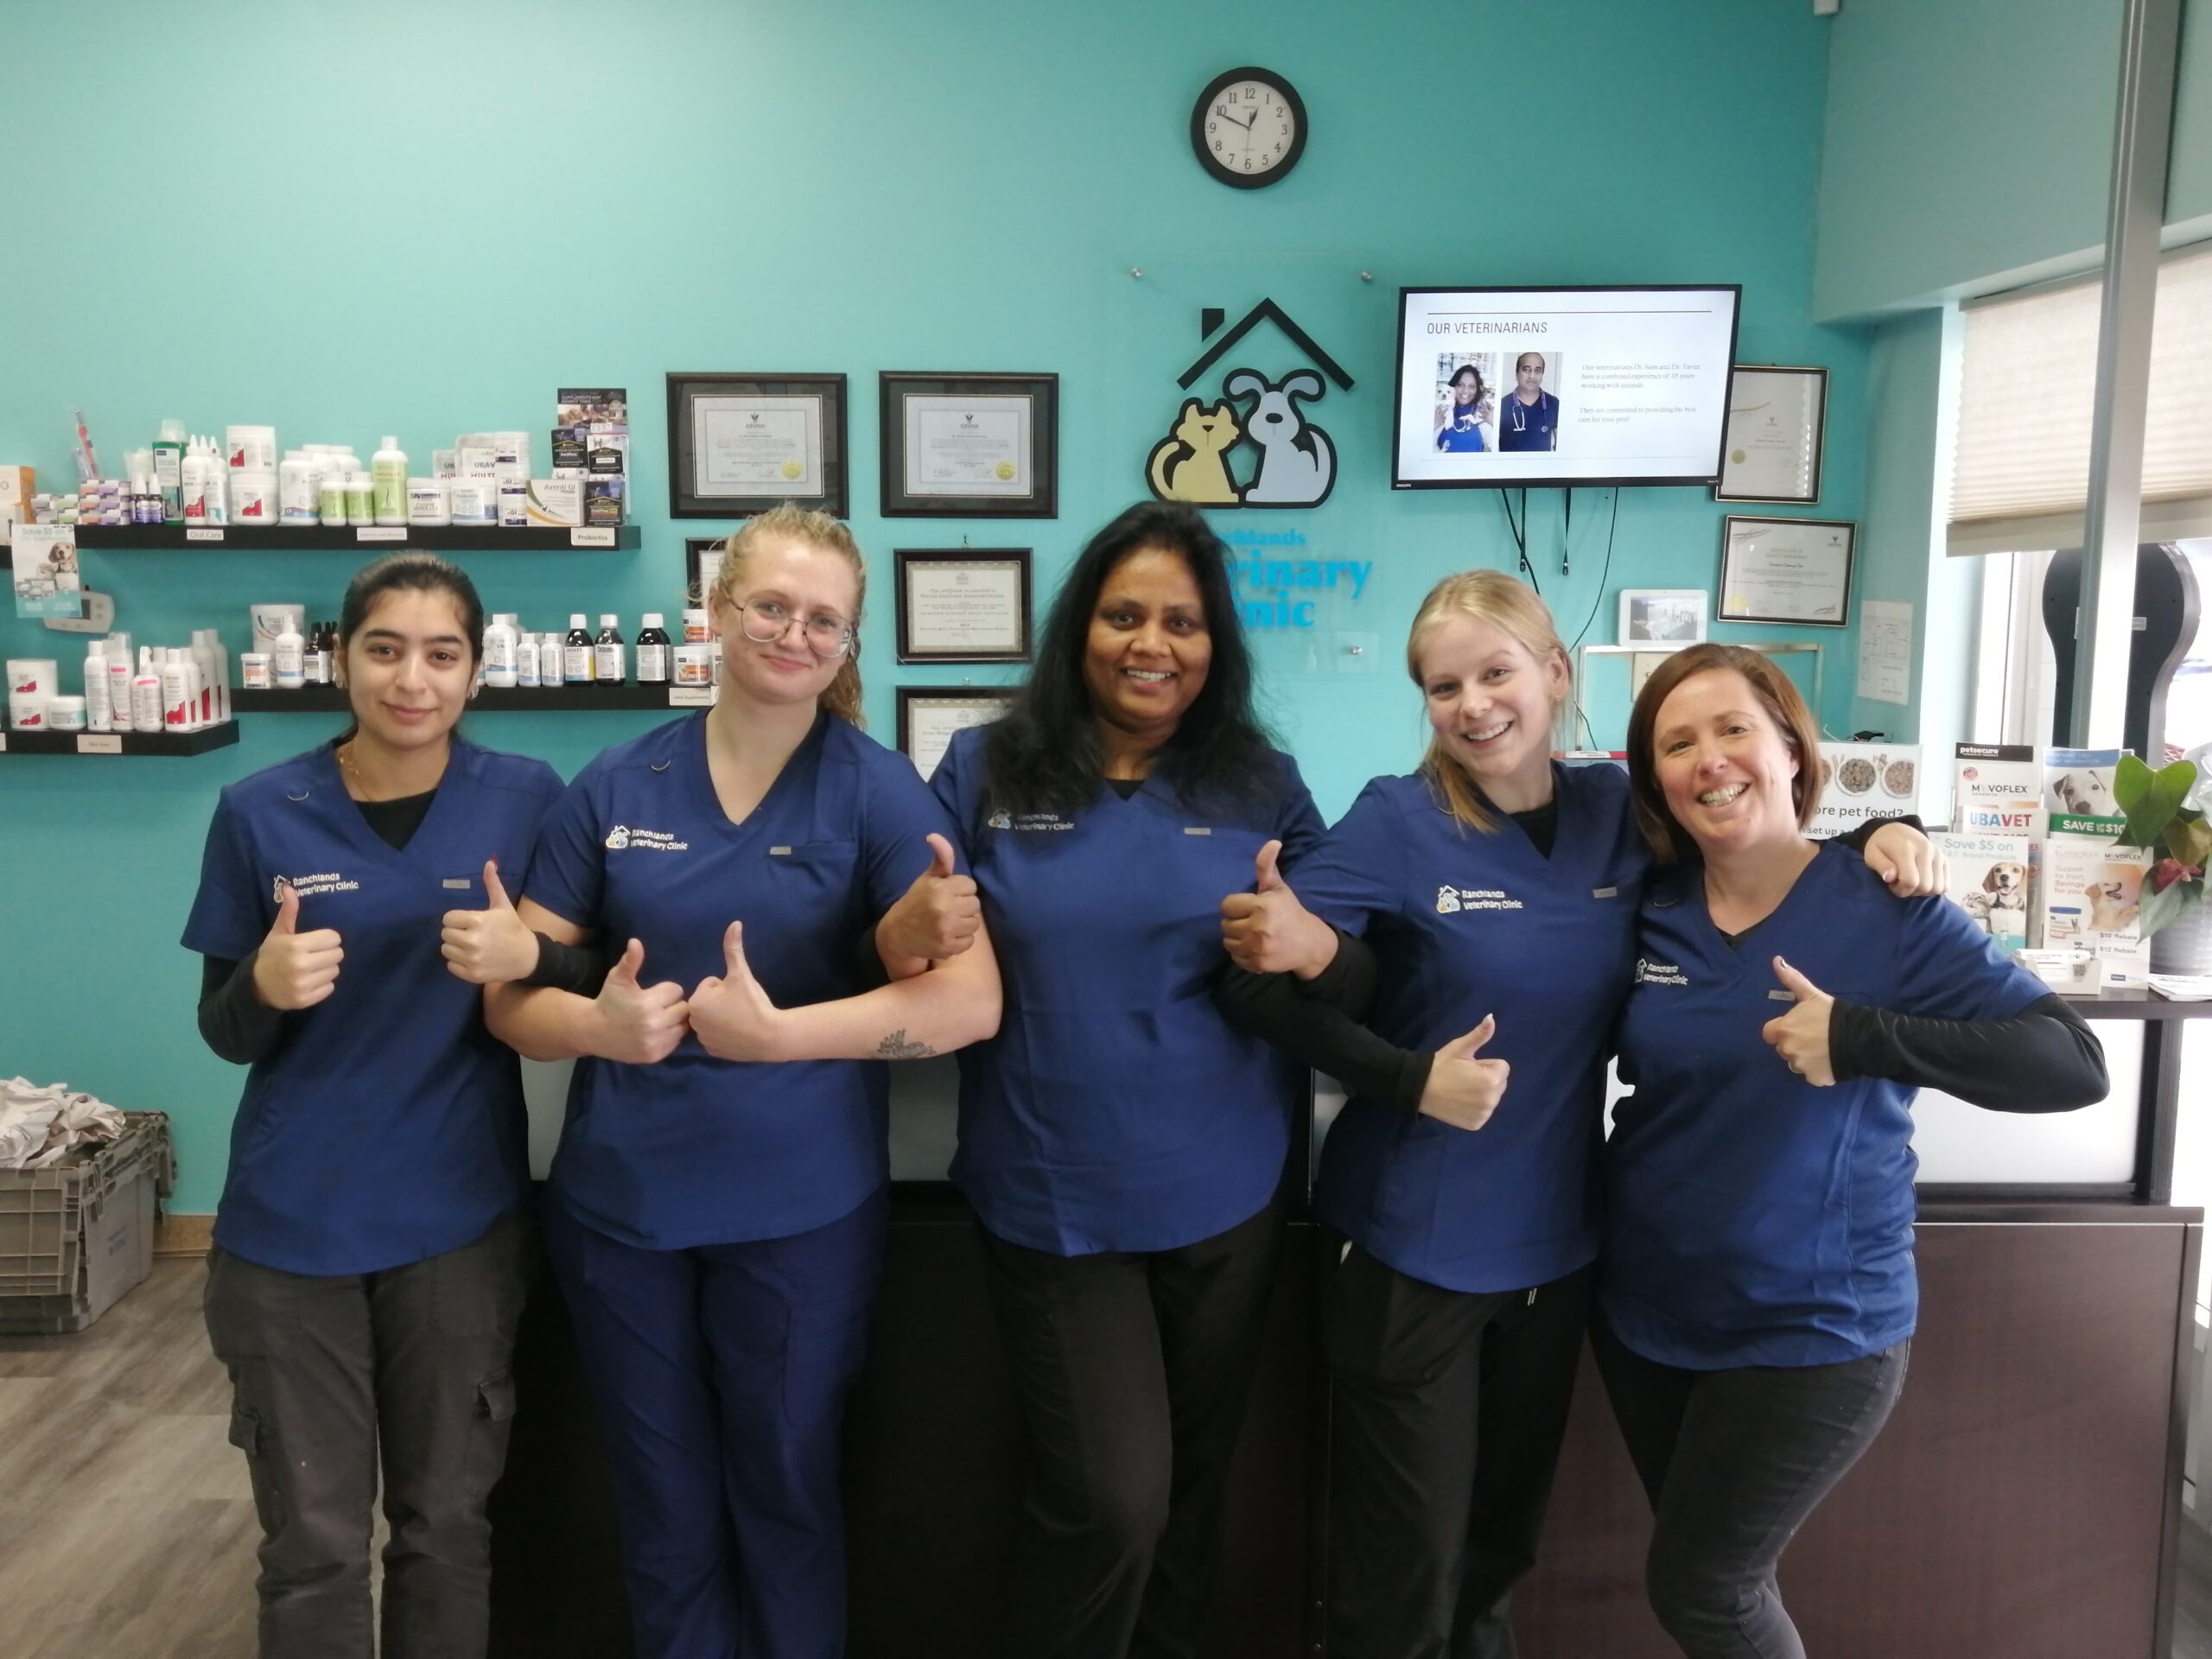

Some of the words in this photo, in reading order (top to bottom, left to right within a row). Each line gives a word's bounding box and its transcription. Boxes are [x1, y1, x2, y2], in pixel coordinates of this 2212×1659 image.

[1228, 92, 1237, 104] 11
[1244, 88, 1255, 99] 12
[1265, 93, 1270, 105] 1
[1216, 105, 1227, 116] 10
[1276, 106, 1283, 118] 2
[1210, 122, 1217, 133] 9
[1281, 124, 1287, 135] 3
[1215, 140, 1223, 151] 8
[1274, 142, 1281, 153] 4
[1229, 153, 1235, 164] 7
[1244, 158, 1251, 169] 6
[1262, 154, 1268, 165] 5
[1427, 322, 1451, 334] OUR
[1454, 321, 1548, 334] VETERINARIANS
[1230, 549, 1373, 600] rinary
[1244, 590, 1315, 628] nic
[1960, 747, 1999, 755] petsecure
[1971, 784, 2028, 794] MVOFLEX
[1839, 806, 1861, 818] pet
[1866, 807, 1904, 819] food?
[1969, 811, 2032, 828] UBAVET
[1053, 822, 1075, 830] Clinic
[2063, 819, 2094, 832] SAVE
[632, 829, 674, 842] Ranchlands
[667, 842, 688, 851] Clinic
[1944, 837, 1976, 850] Save
[1979, 839, 1994, 851] $5
[1997, 842, 2014, 851] on
[293, 873, 340, 887] Ranchlands
[335, 880, 359, 891] Clinic
[1462, 889, 1505, 899] Ranchlands
[1463, 900, 1502, 911] Veterinary
[1502, 899, 1523, 909] Clinic
